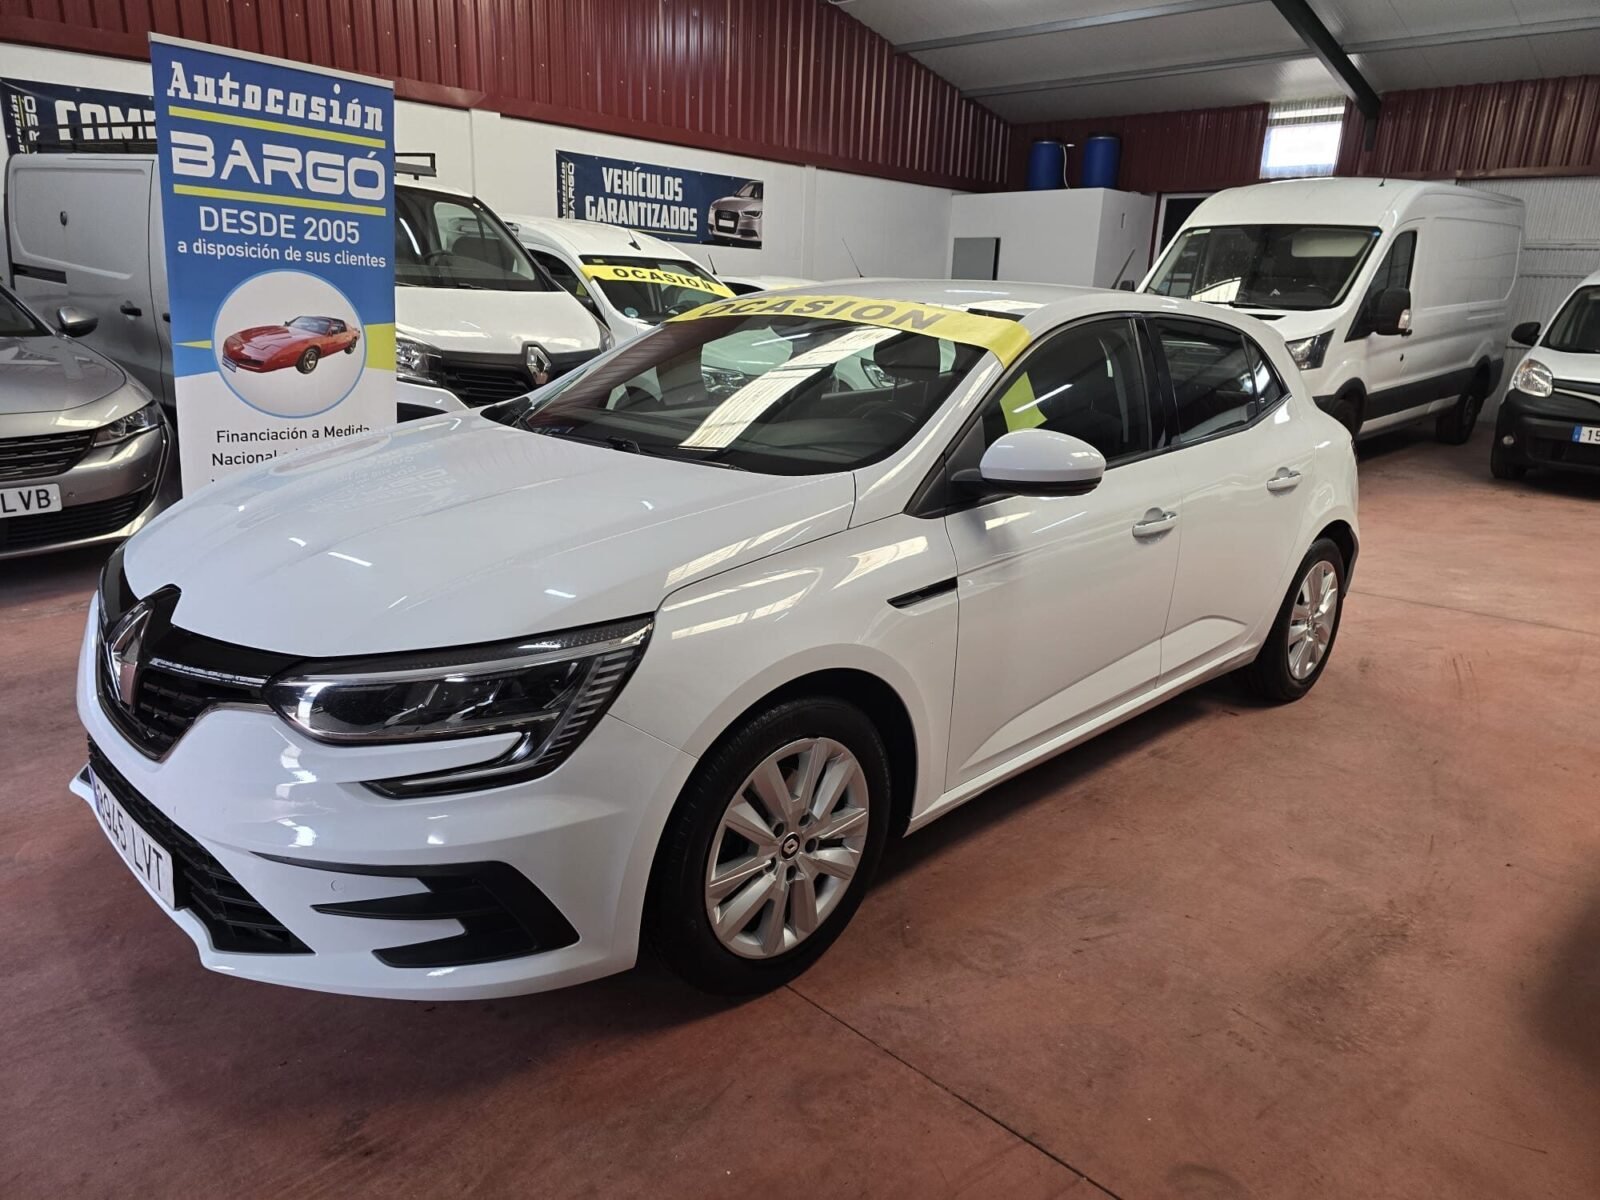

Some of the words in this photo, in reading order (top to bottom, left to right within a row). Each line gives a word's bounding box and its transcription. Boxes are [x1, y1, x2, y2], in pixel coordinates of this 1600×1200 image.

[167, 61, 383, 132] Autocasión
[170, 130, 386, 201] BARGÓ
[601, 166, 683, 202] VEHÍCULOS
[199, 205, 296, 239] DESDE
[303, 217, 360, 244] 2005
[584, 195, 698, 232] GARANTIZADOS
[177, 241, 187, 253] a
[192, 238, 280, 261] disposición
[284, 246, 301, 262] de
[305, 252, 331, 264] sus
[334, 248, 387, 268] clientes
[612, 268, 715, 292] OCASION
[703, 299, 947, 331] OCASION
[216, 427, 308, 443] Financiación
[311, 430, 320, 439] a
[0, 488, 51, 513] LVB
[131, 825, 163, 892] LVT
